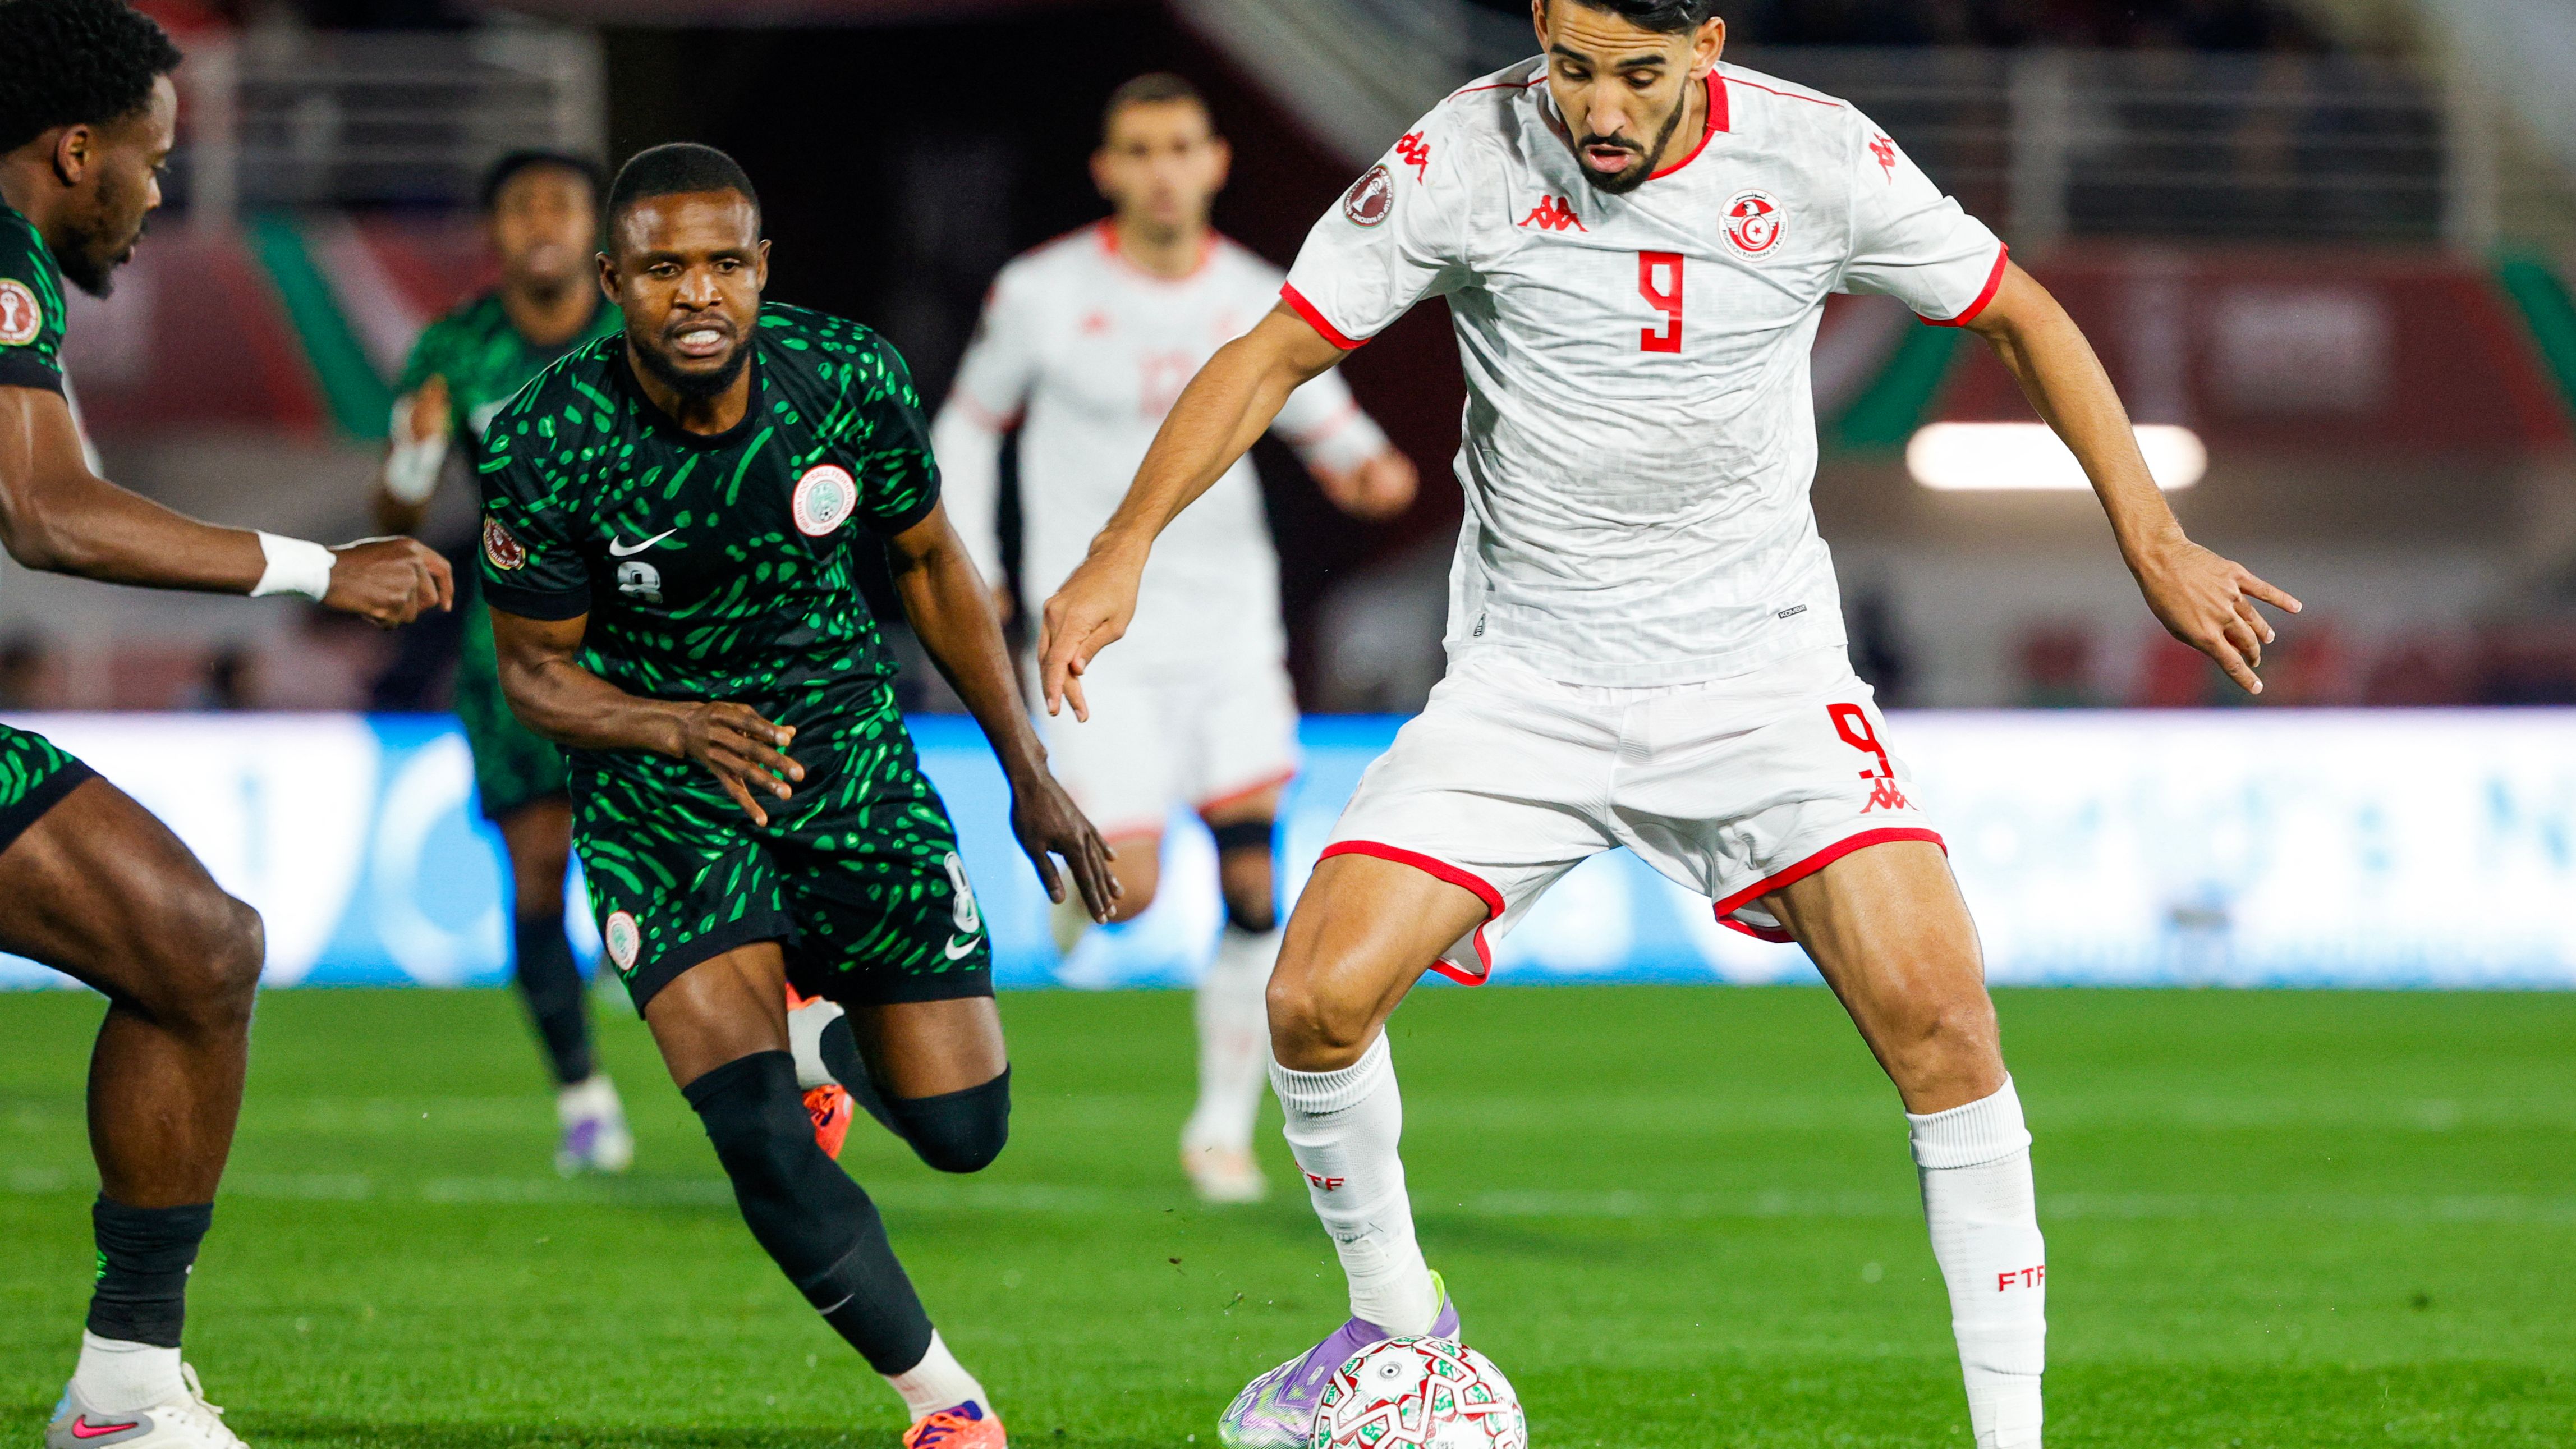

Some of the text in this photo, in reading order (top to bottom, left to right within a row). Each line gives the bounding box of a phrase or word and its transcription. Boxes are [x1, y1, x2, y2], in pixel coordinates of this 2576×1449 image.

[1351, 213, 1378, 224] NATIONS
[1383, 199, 1392, 213] CUP
[1638, 250, 1683, 354] 9
[797, 470, 829, 499] FOOTBALL
[831, 470, 852, 515] FEDERATION
[1779, 605, 1806, 618] KOMBAT
[1826, 703, 1895, 779] 9
[943, 851, 980, 934] 8
[1998, 1265, 2045, 1292] FTF
